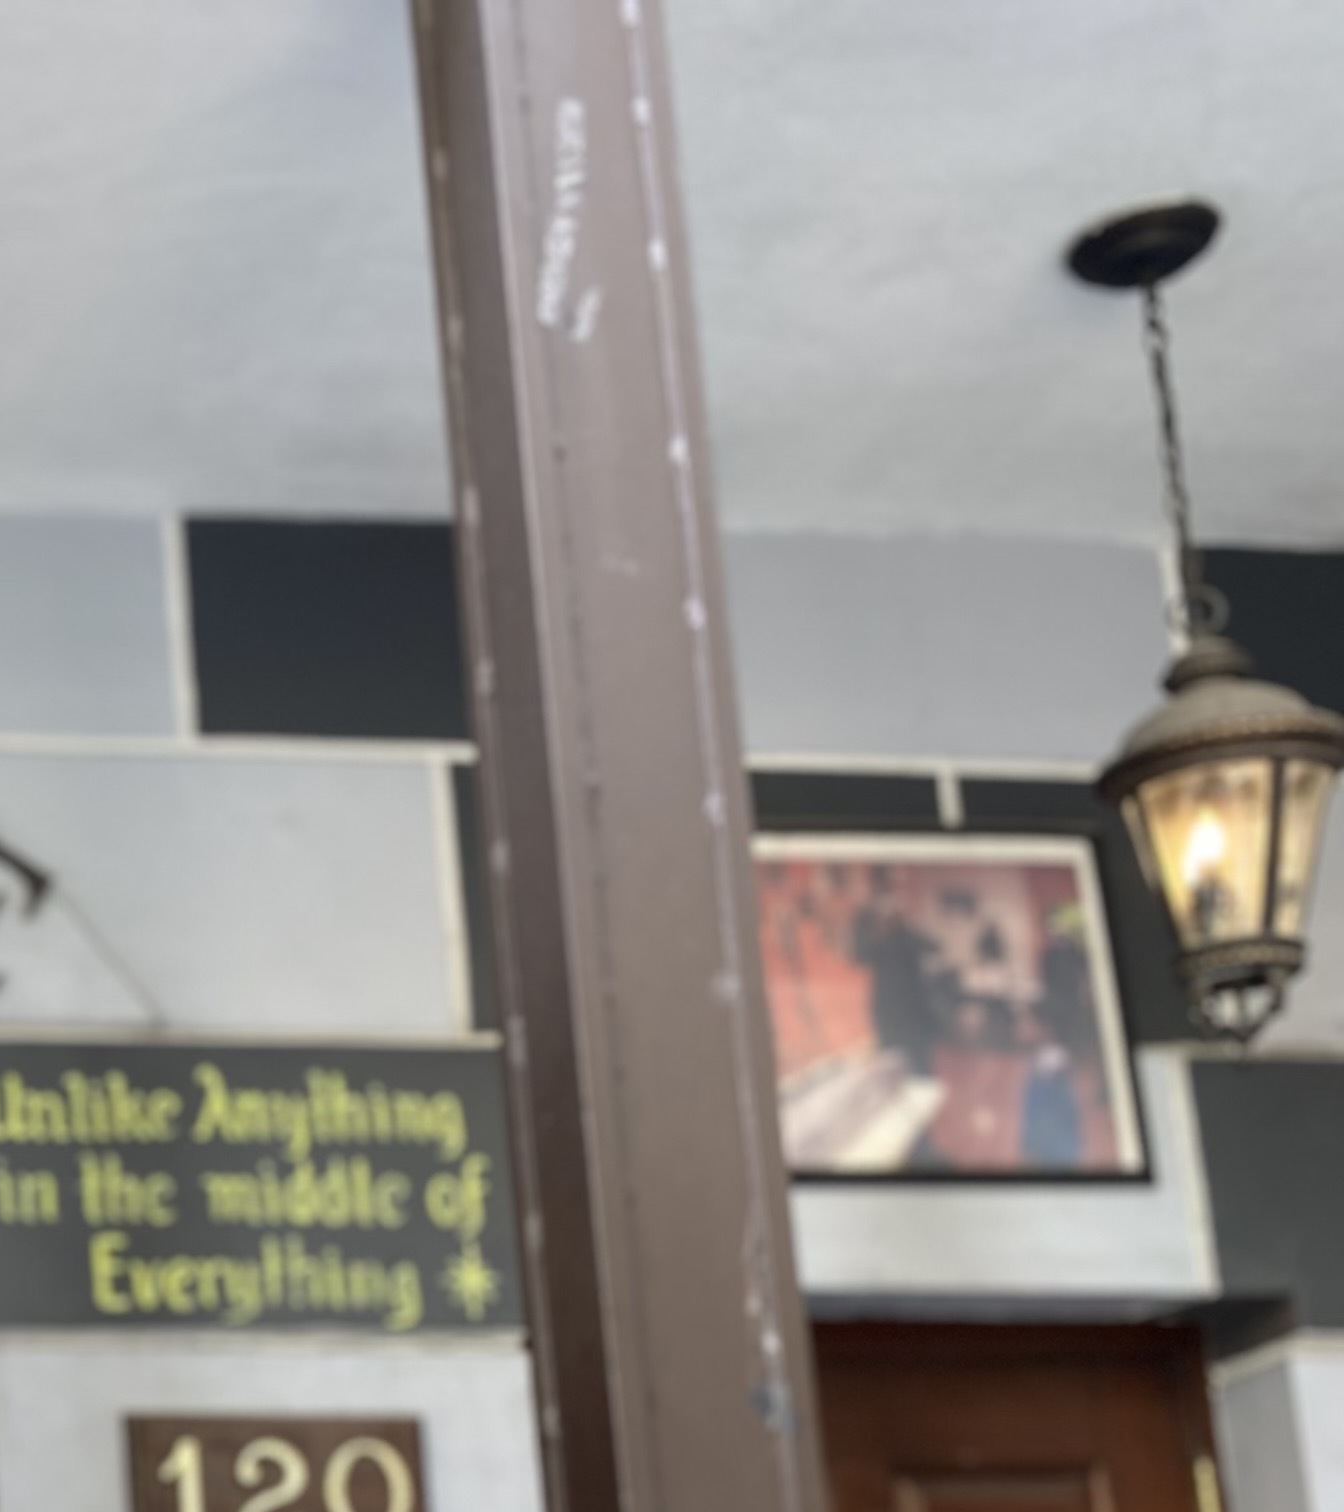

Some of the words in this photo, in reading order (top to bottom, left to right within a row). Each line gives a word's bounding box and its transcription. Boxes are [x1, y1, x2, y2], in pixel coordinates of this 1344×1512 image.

[190, 1062, 468, 1163] Anything
[76, 1150, 178, 1227] the
[198, 1154, 409, 1228] middle
[422, 1152, 491, 1240] of
[89, 1230, 424, 1332] Everything
